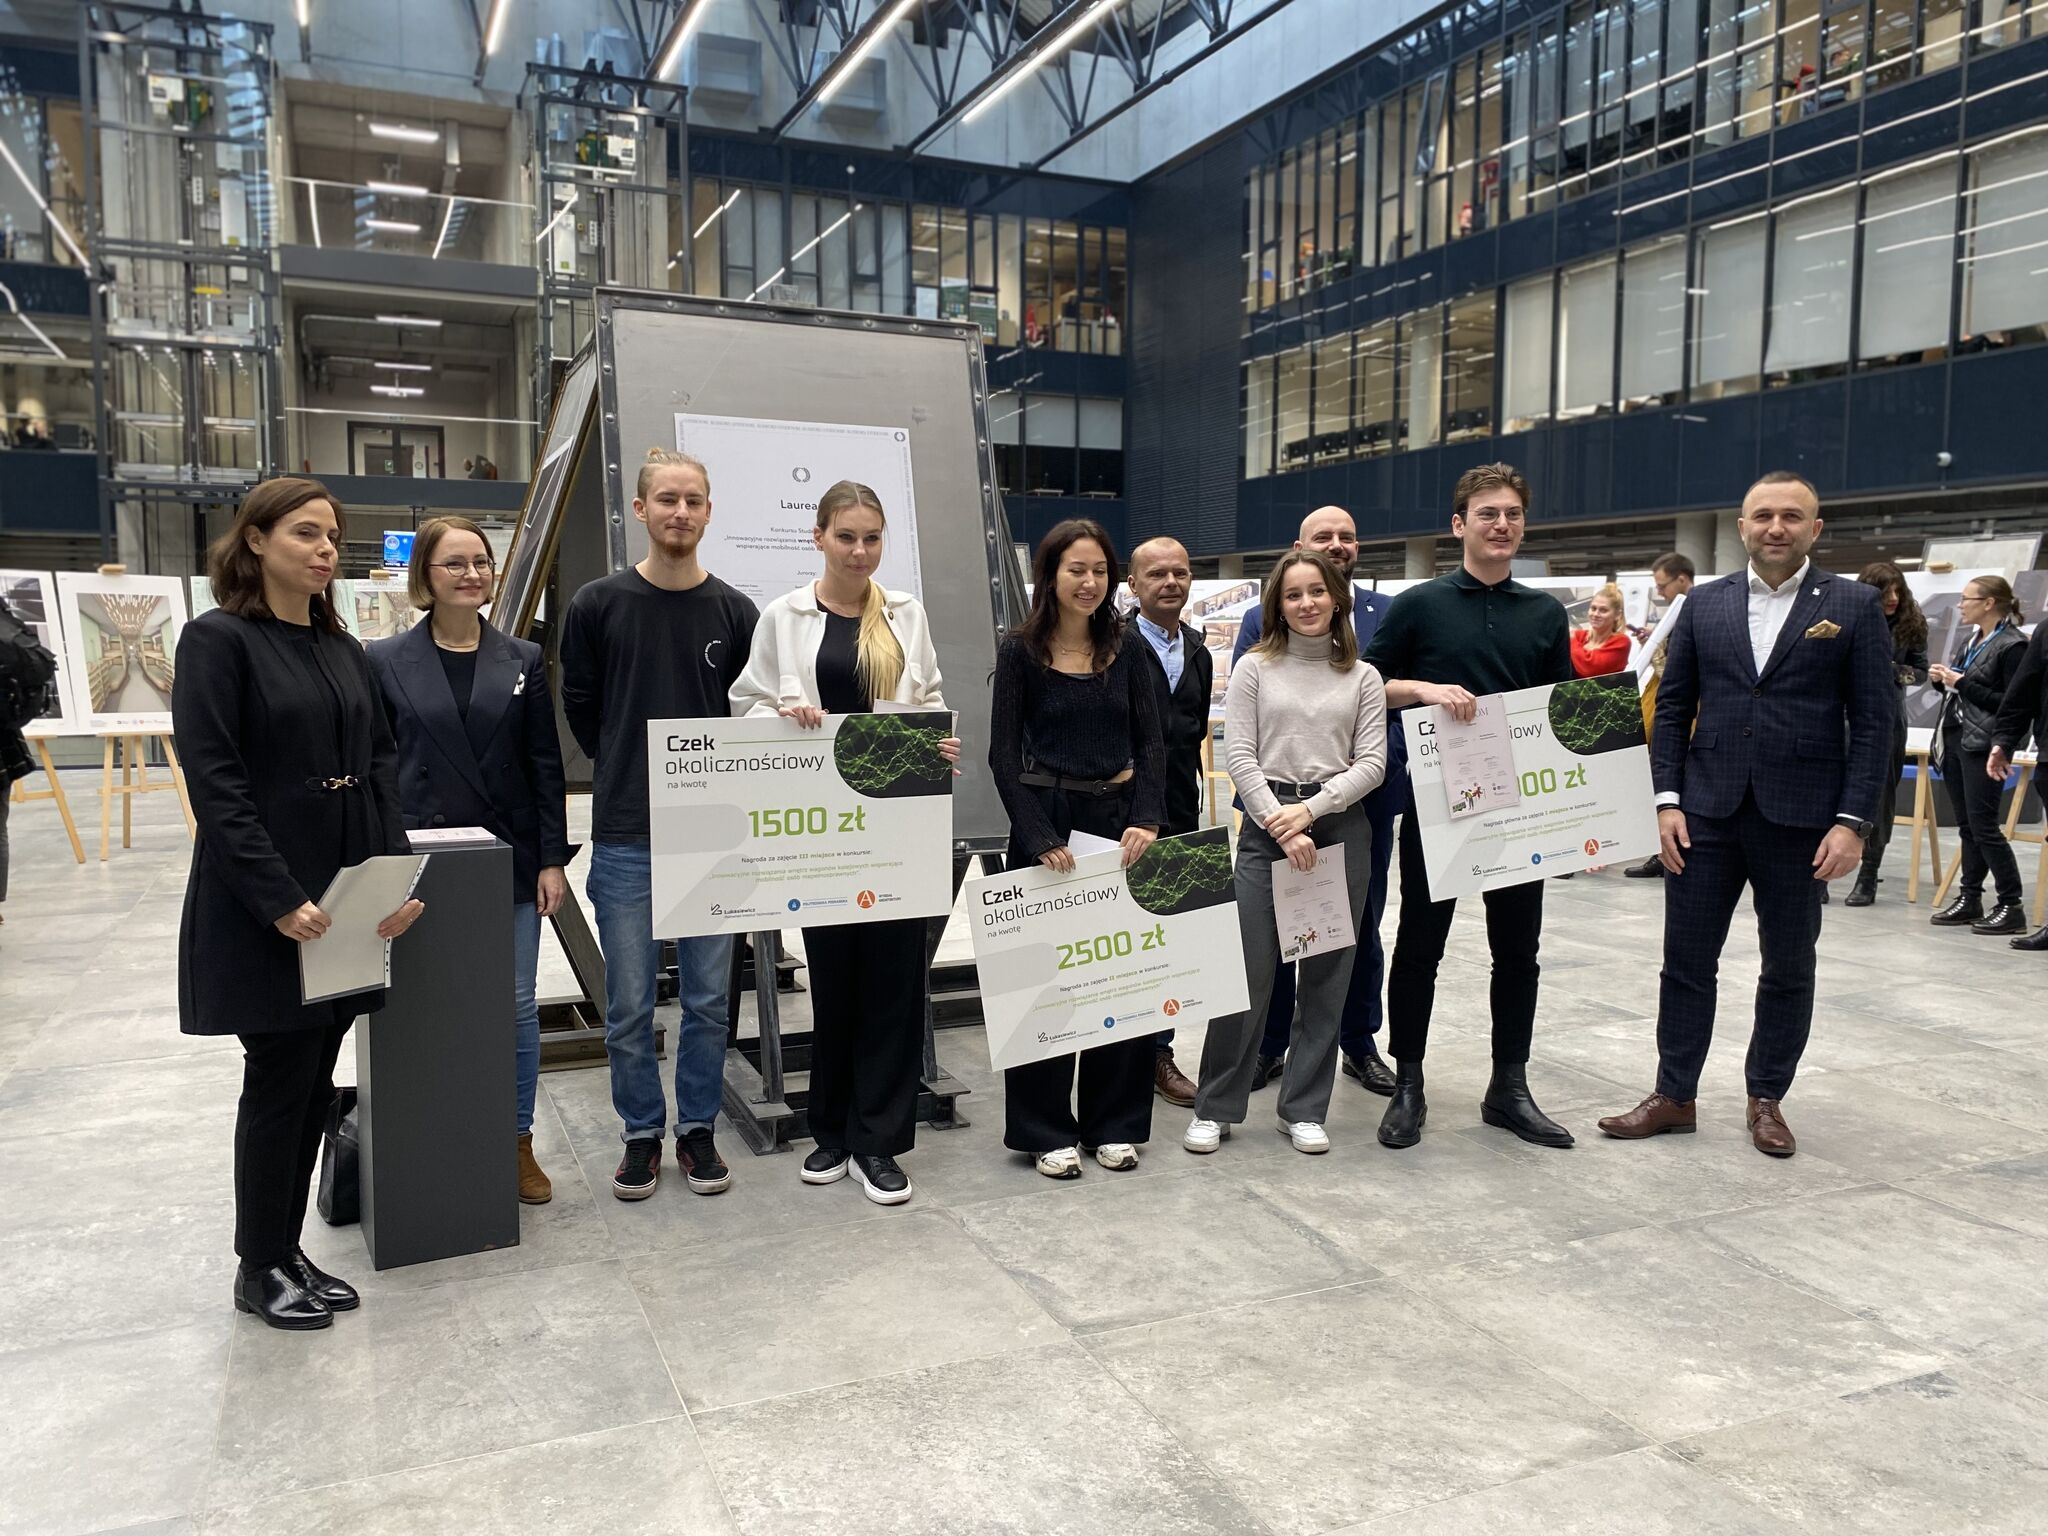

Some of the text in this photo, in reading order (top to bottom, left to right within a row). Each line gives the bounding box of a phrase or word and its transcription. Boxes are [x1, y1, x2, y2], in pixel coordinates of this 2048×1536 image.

[780, 499, 818, 511] Laurea
[1418, 721, 1435, 736] Cz
[667, 734, 714, 752] Czek
[666, 753, 824, 774] okolicznościowy
[680, 780, 707, 789] kwotę
[1516, 768, 1556, 796] 00
[1564, 763, 1587, 789] zł
[748, 805, 865, 837] 1500 zł
[982, 885, 1023, 905] Czek
[984, 886, 1119, 925] okolicznościowy
[998, 926, 1021, 935] kwotę
[1056, 923, 1165, 970] 2500 zł
[1059, 984, 1081, 992] Nagroda
